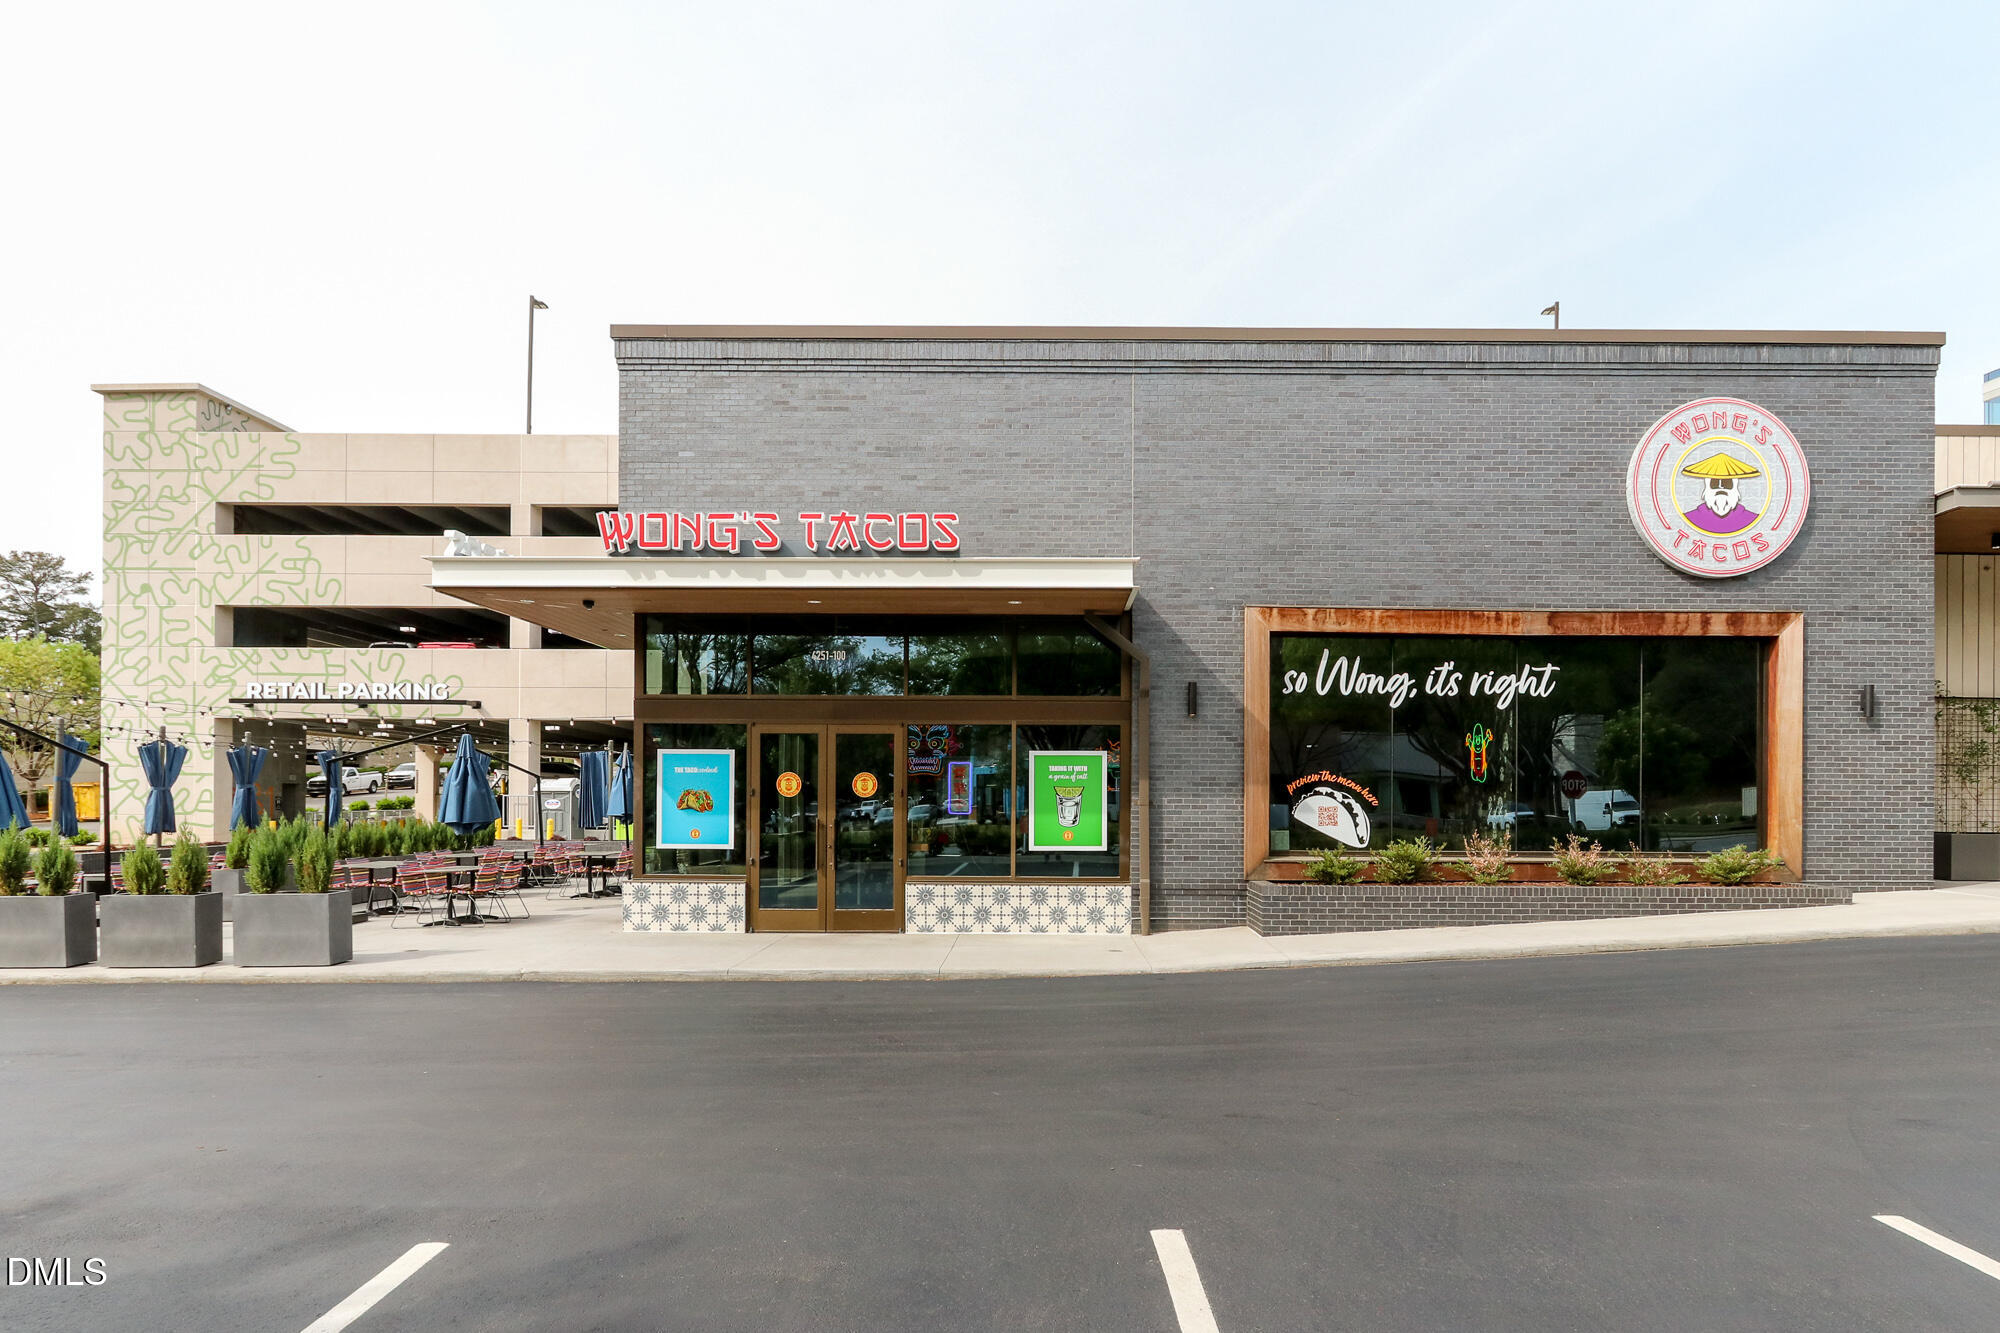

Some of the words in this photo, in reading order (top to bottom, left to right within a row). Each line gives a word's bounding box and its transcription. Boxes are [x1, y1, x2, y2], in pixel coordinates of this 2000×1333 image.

[1671, 411, 1773, 444] WONG'S
[595, 510, 781, 555] WONG'S
[797, 511, 961, 553] TACOS
[1673, 529, 1770, 562] TACOS
[811, 650, 846, 661] 4251-100
[246, 682, 332, 700] RETAIL
[338, 682, 450, 701] PARKING
[1282, 669, 1308, 694] so
[1315, 648, 1418, 709] Wong,
[1425, 660, 1463, 697] it's
[1469, 662, 1561, 710] right
[1286, 774, 1320, 796] preview
[1320, 770, 1338, 782] the
[1337, 776, 1363, 793] menu
[1361, 787, 1378, 806] here
